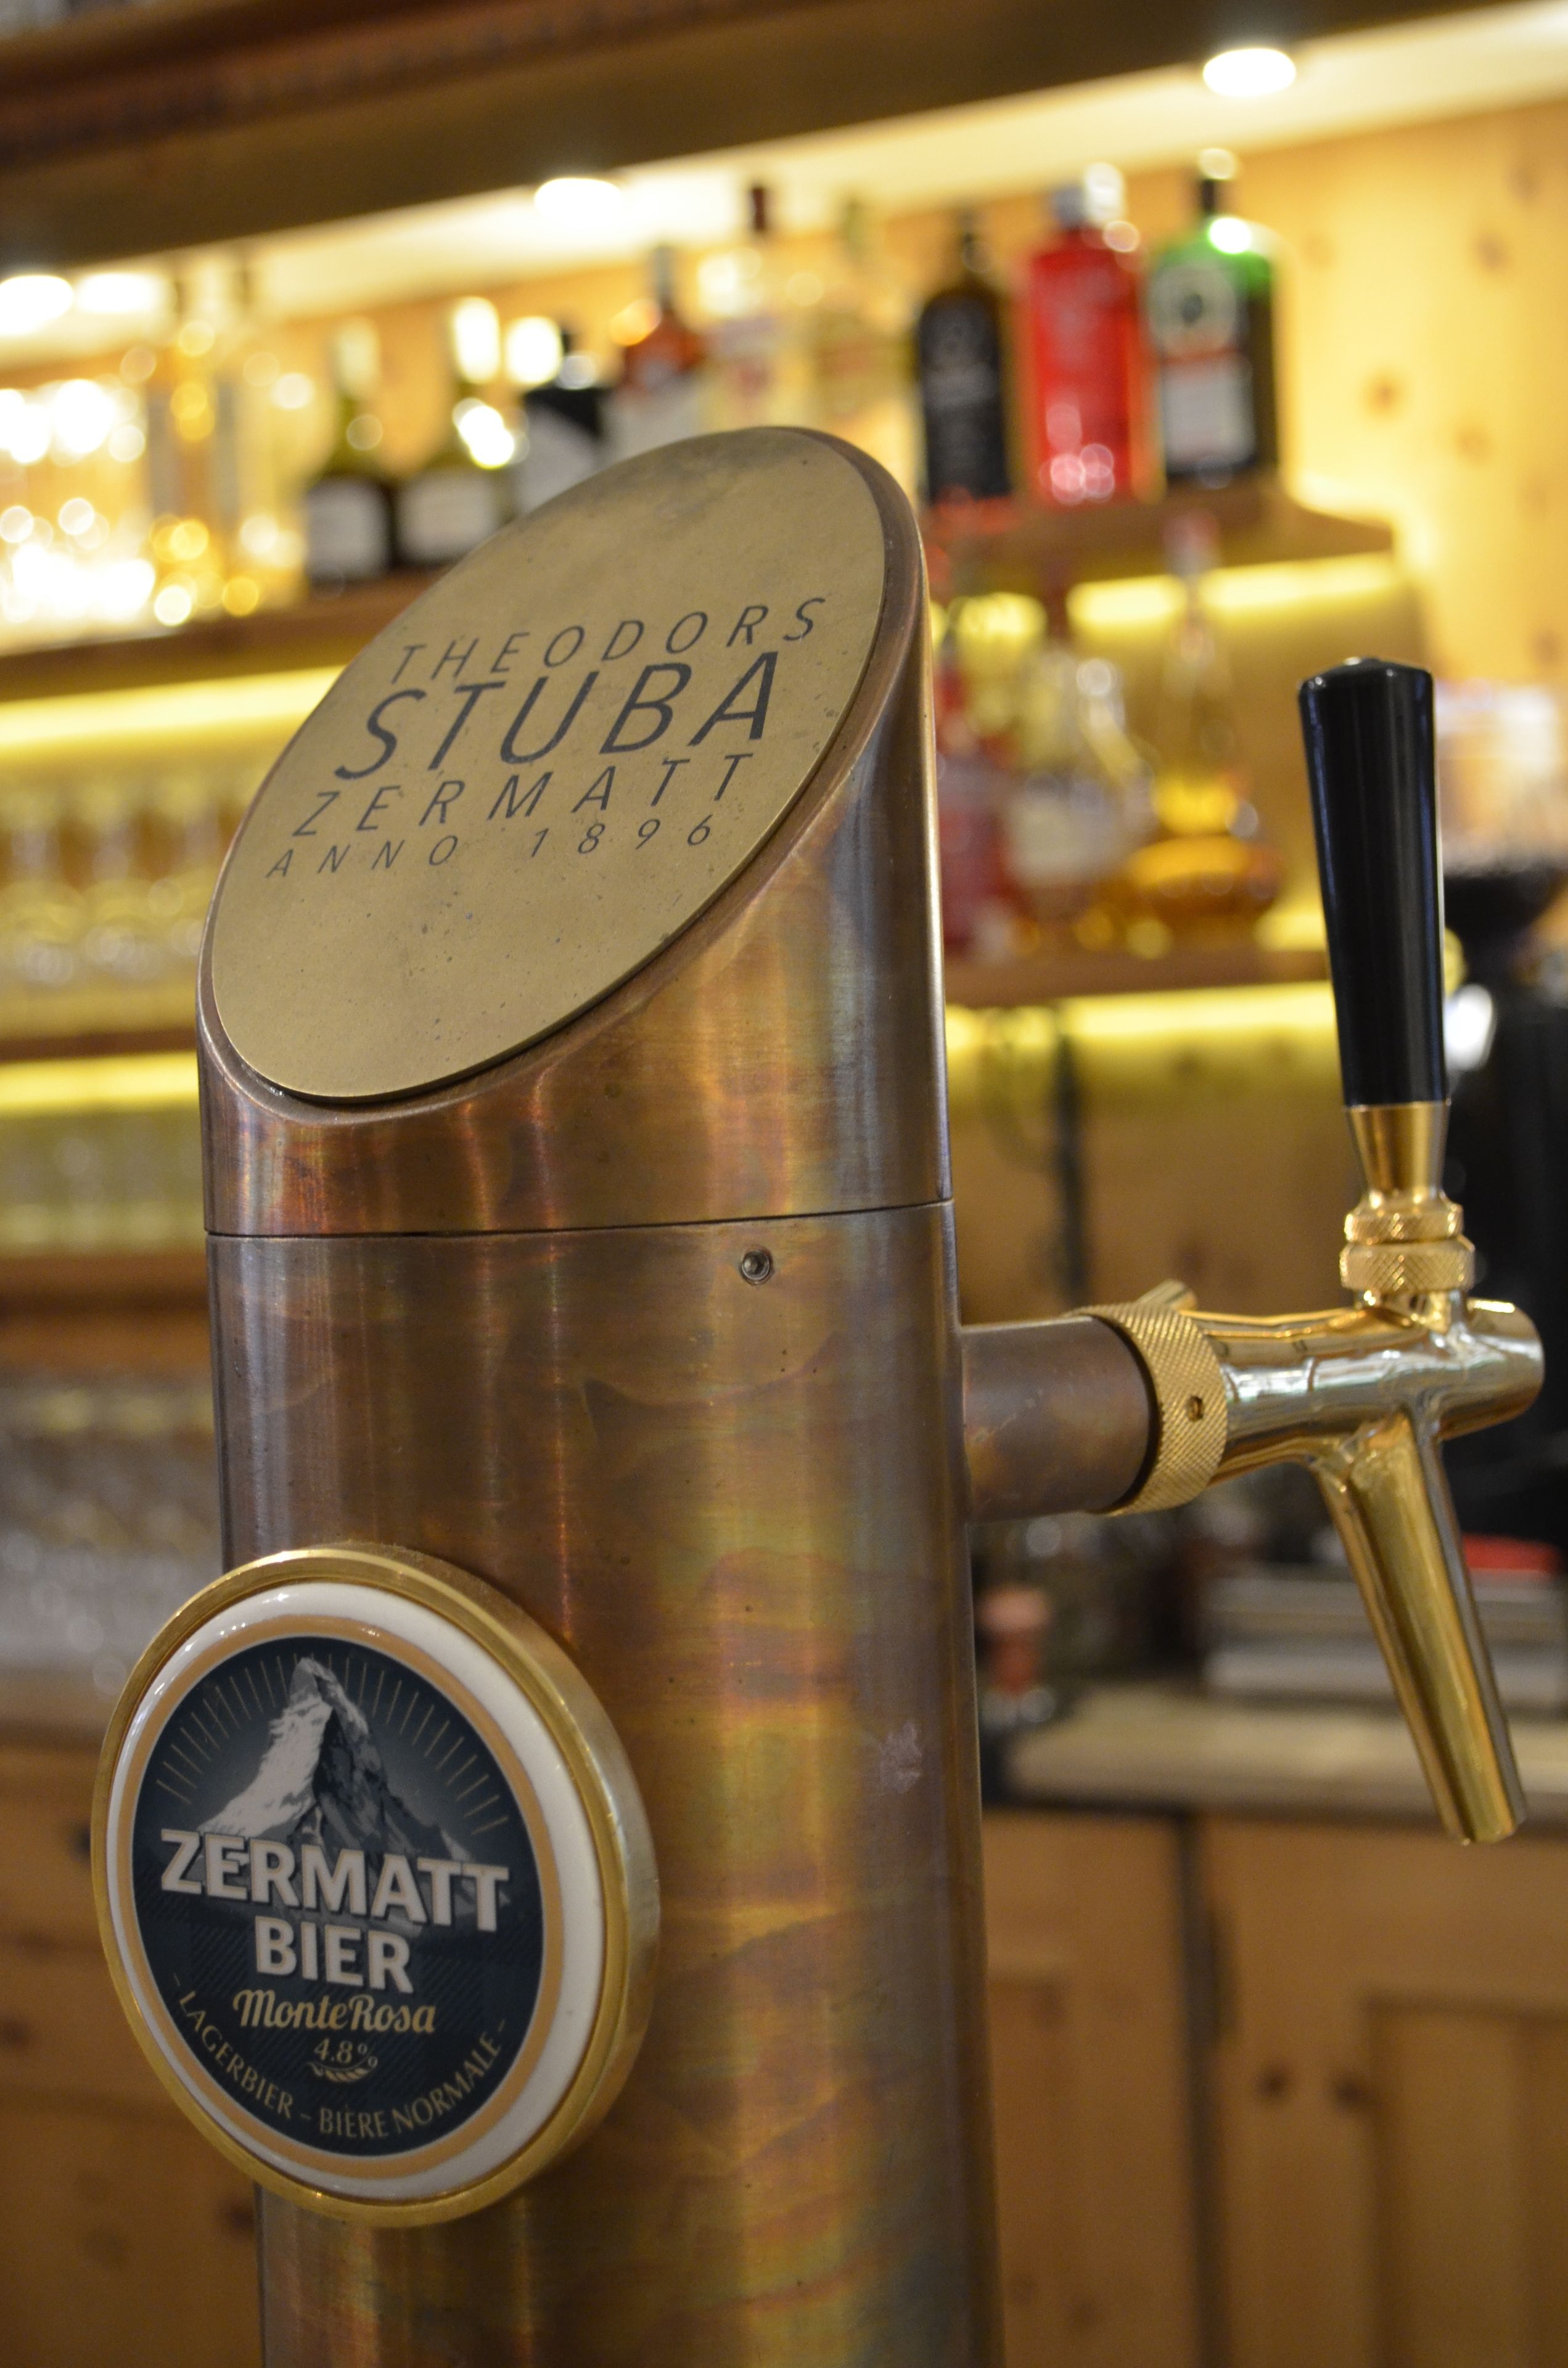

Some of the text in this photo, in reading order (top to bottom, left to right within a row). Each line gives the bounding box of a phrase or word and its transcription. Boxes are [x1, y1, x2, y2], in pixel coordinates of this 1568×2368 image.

[392, 598, 826, 684] THEODORS
[334, 651, 779, 780] STUBA
[293, 754, 753, 837] ZERMATT
[265, 815, 713, 878] ANNO 1896
[160, 1828, 510, 1933] ZERMATT
[254, 1914, 415, 1995] BIER
[179, 1990, 293, 2119] LAGERBIER
[392, 2031, 501, 2133] NORMALE
